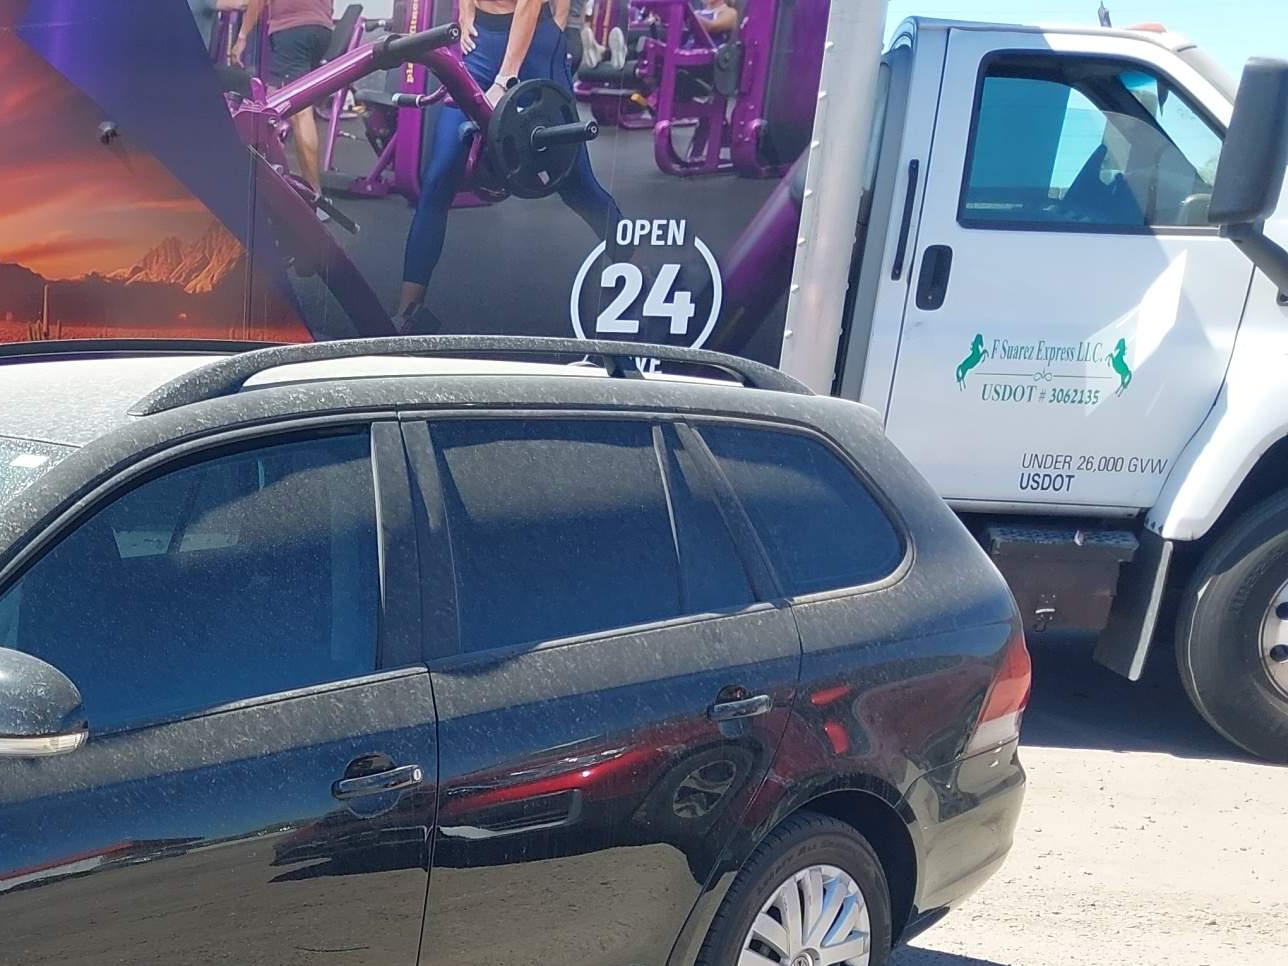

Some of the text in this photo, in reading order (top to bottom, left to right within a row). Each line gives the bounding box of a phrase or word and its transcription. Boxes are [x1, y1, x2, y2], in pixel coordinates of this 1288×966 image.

[616, 219, 686, 246] OPEN
[595, 262, 696, 335] 24
[991, 338, 1103, 367] F Suarez Express LLC.
[981, 383, 1101, 405] USDOT # 3062135
[1021, 453, 1169, 475] UNDER 26,000 GVW
[1019, 472, 1075, 492] USDOT
